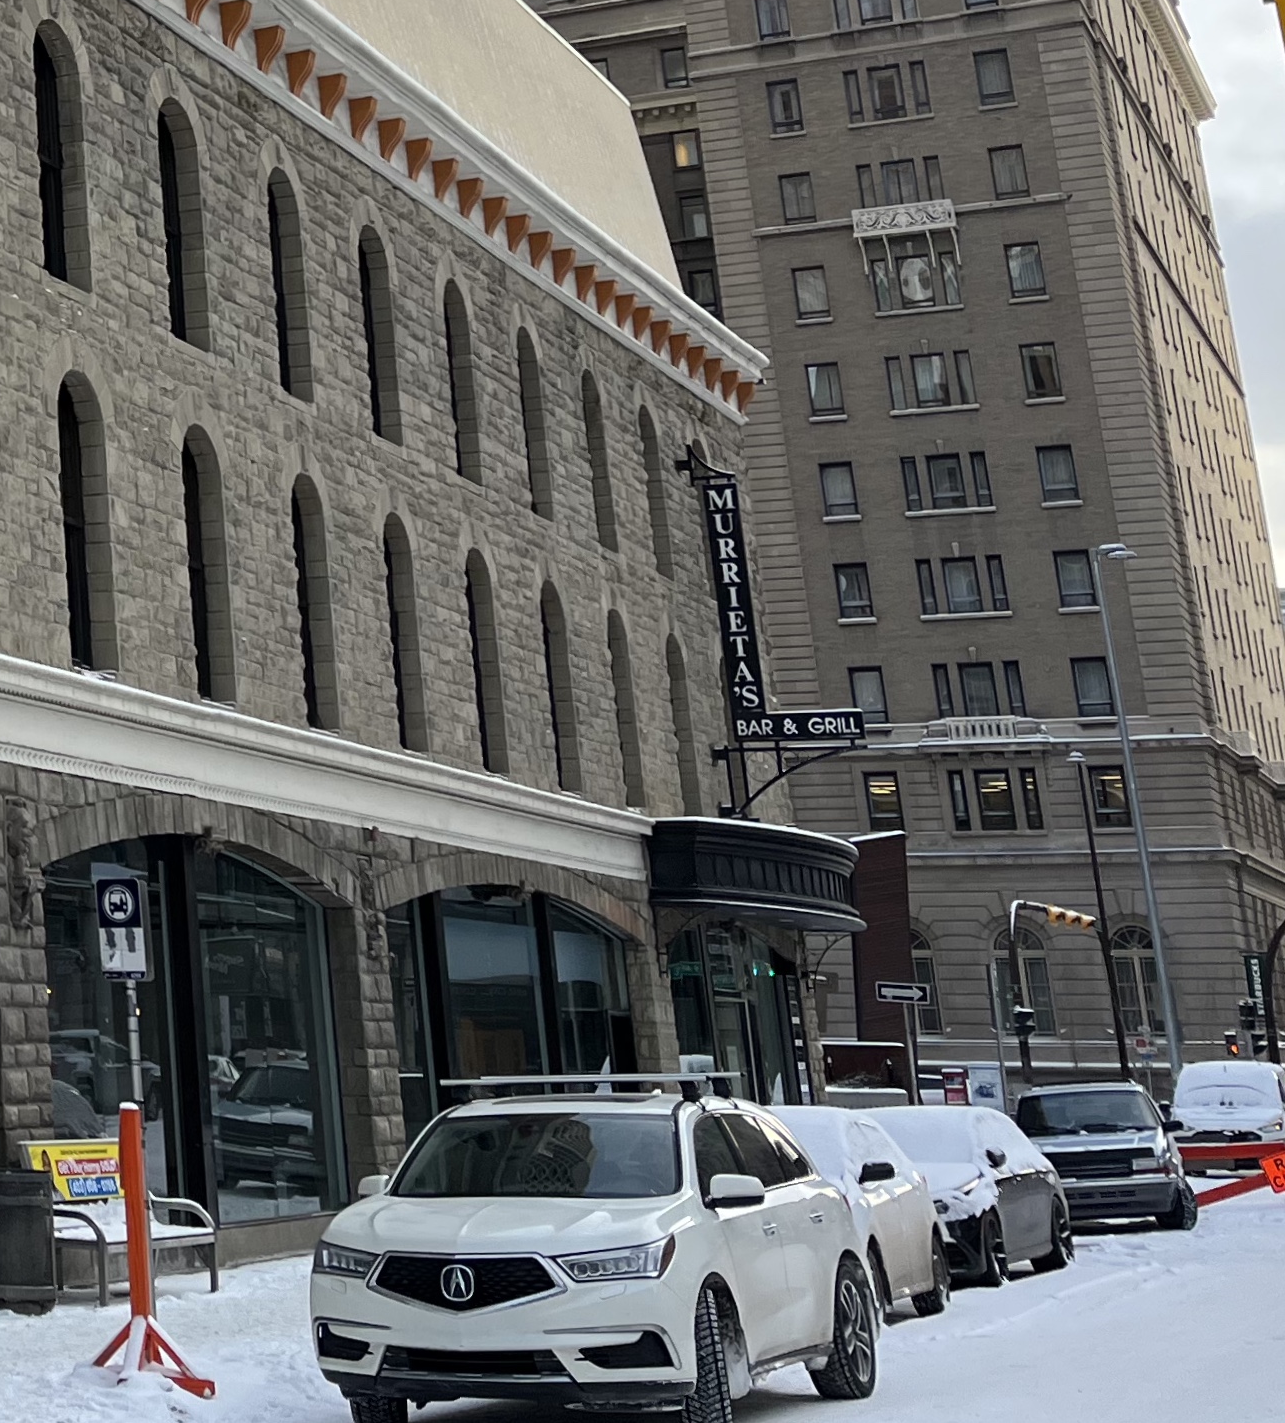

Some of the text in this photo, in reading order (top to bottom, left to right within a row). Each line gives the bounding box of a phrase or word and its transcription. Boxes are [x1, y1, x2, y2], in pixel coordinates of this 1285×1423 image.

[706, 488, 760, 708] MURRIETA'S
[736, 717, 861, 736] BAR & GRILL
